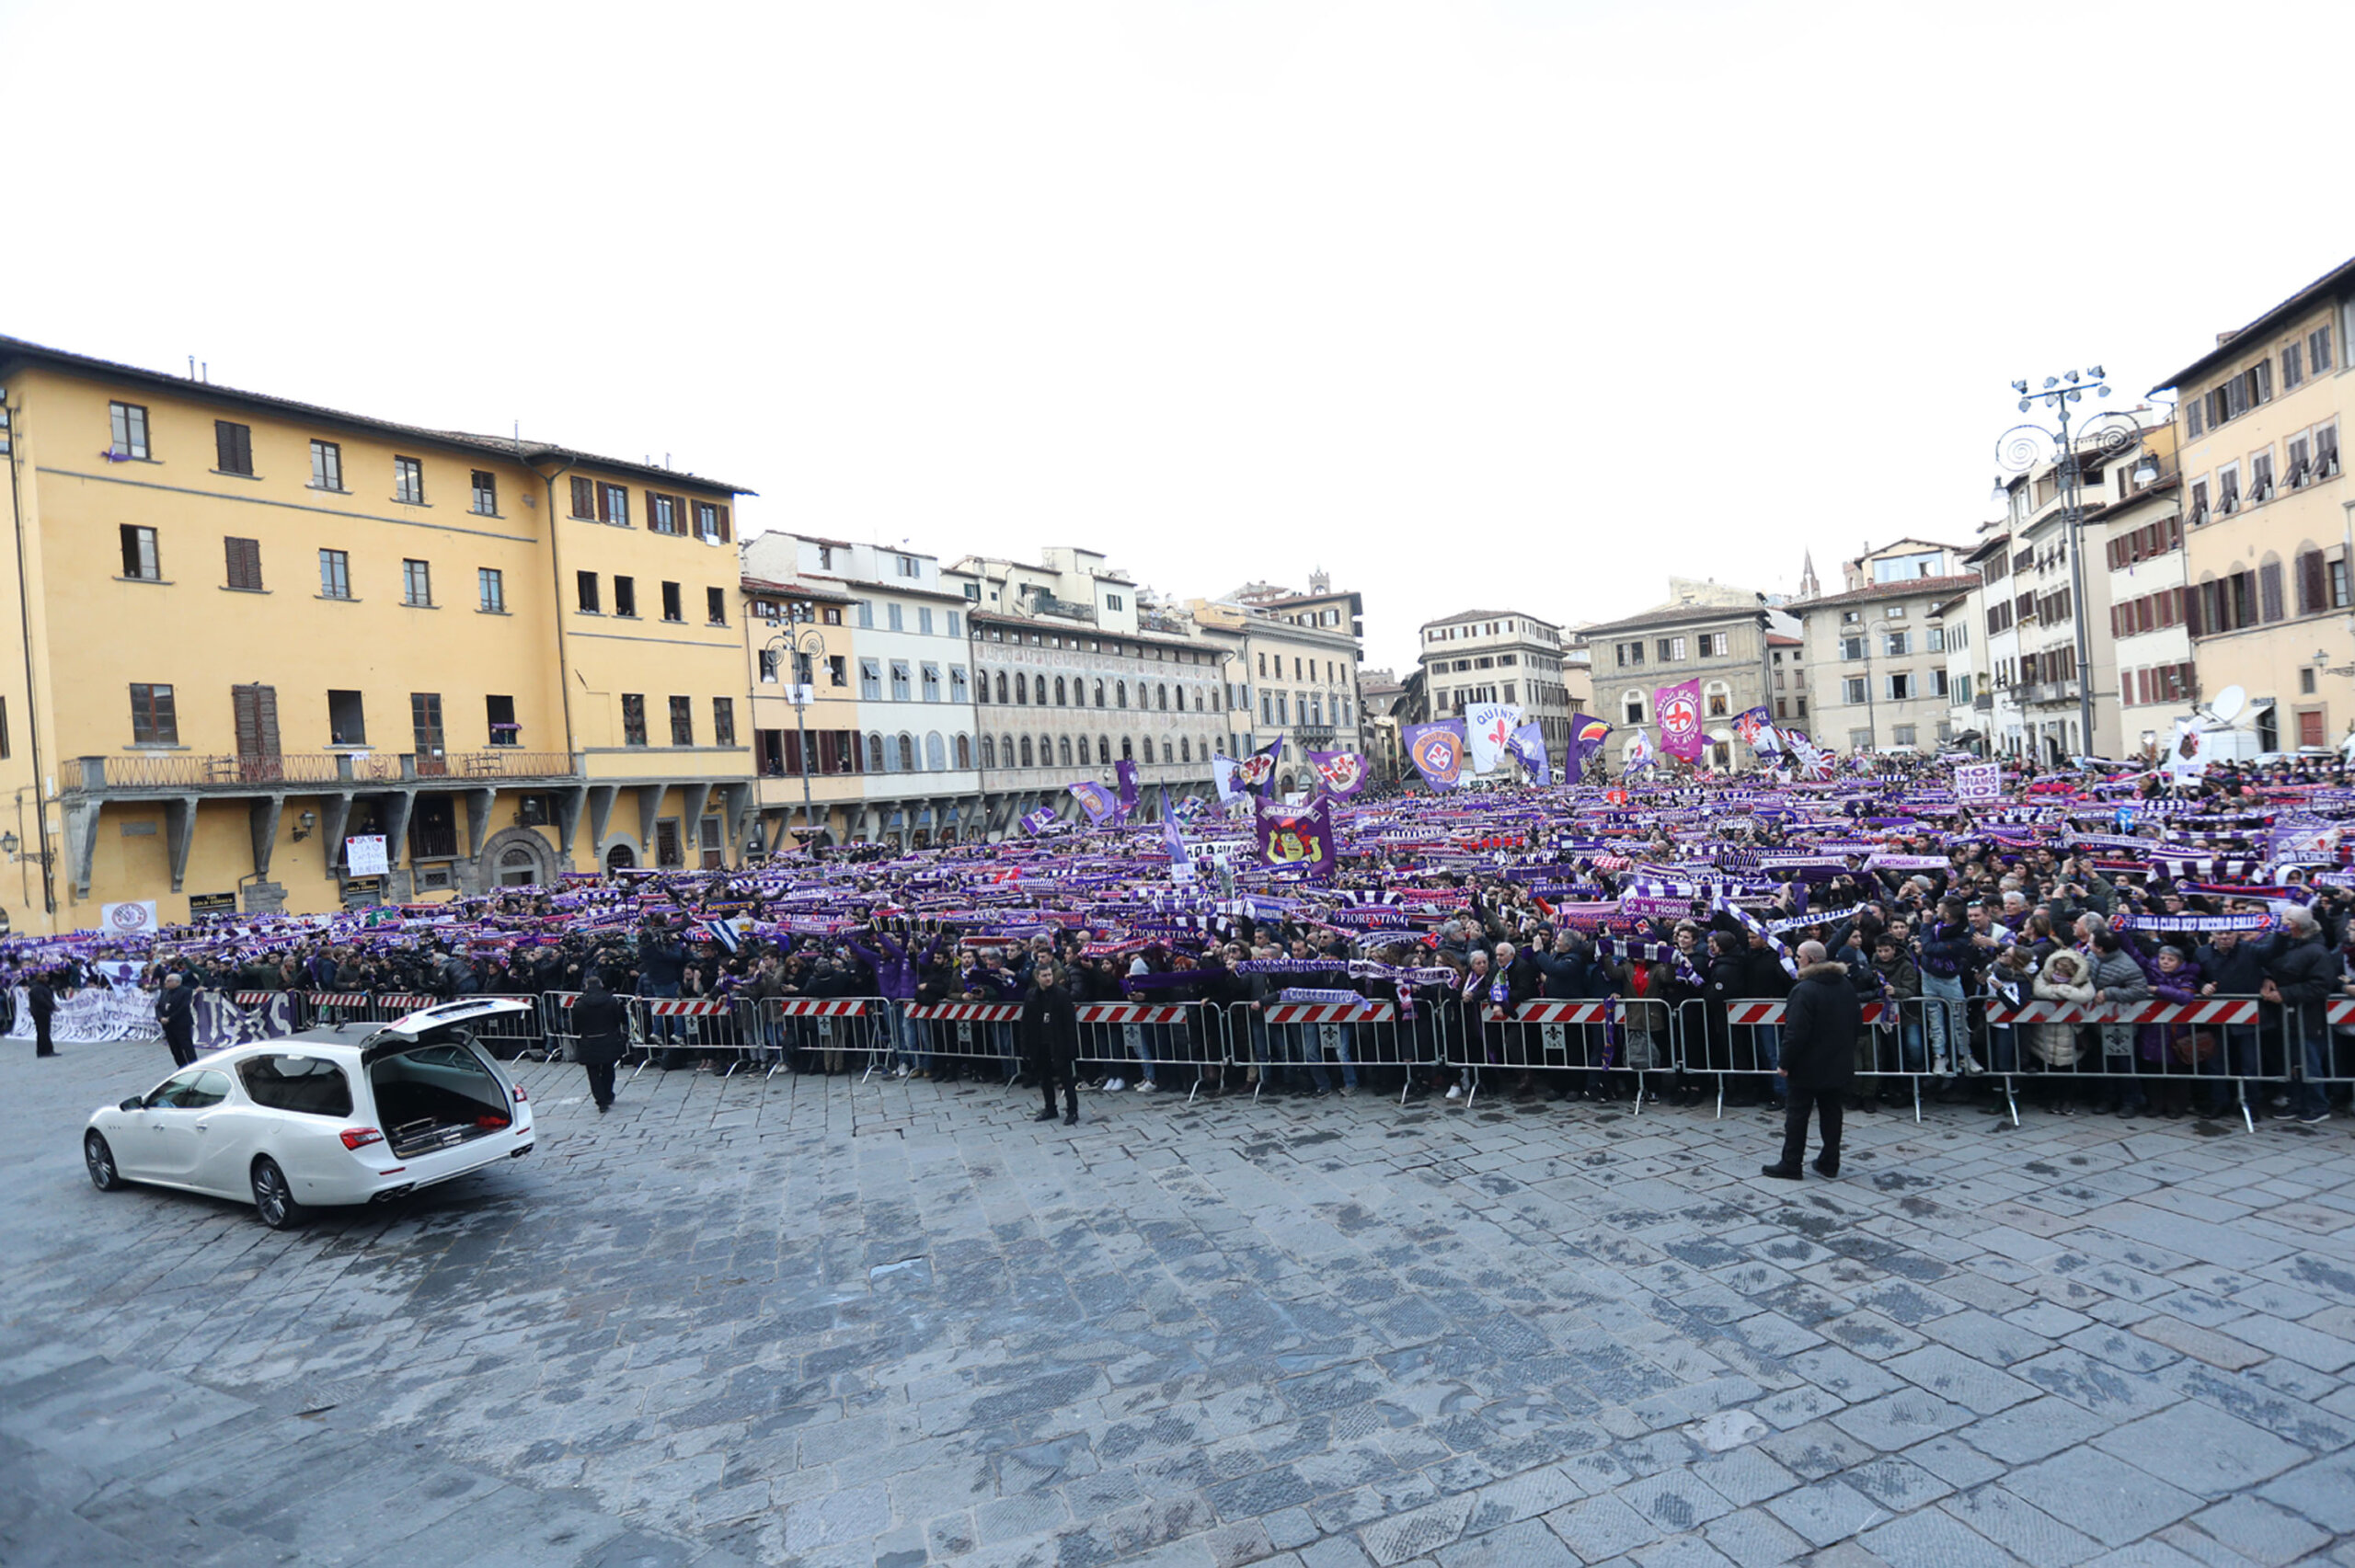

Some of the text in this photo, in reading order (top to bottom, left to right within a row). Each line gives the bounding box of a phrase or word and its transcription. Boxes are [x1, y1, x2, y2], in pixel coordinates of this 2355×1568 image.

[1748, 849, 1807, 857] FIORENTINA
[1640, 902, 1649, 911] la
[1339, 912, 1405, 925] FIORENTINA
[2137, 916, 2158, 930] VIOLA
[2160, 917, 2180, 931] CLUB
[1132, 928, 1196, 939] FIORENTINA
[1288, 988, 1354, 1004] COLLETTIVO
